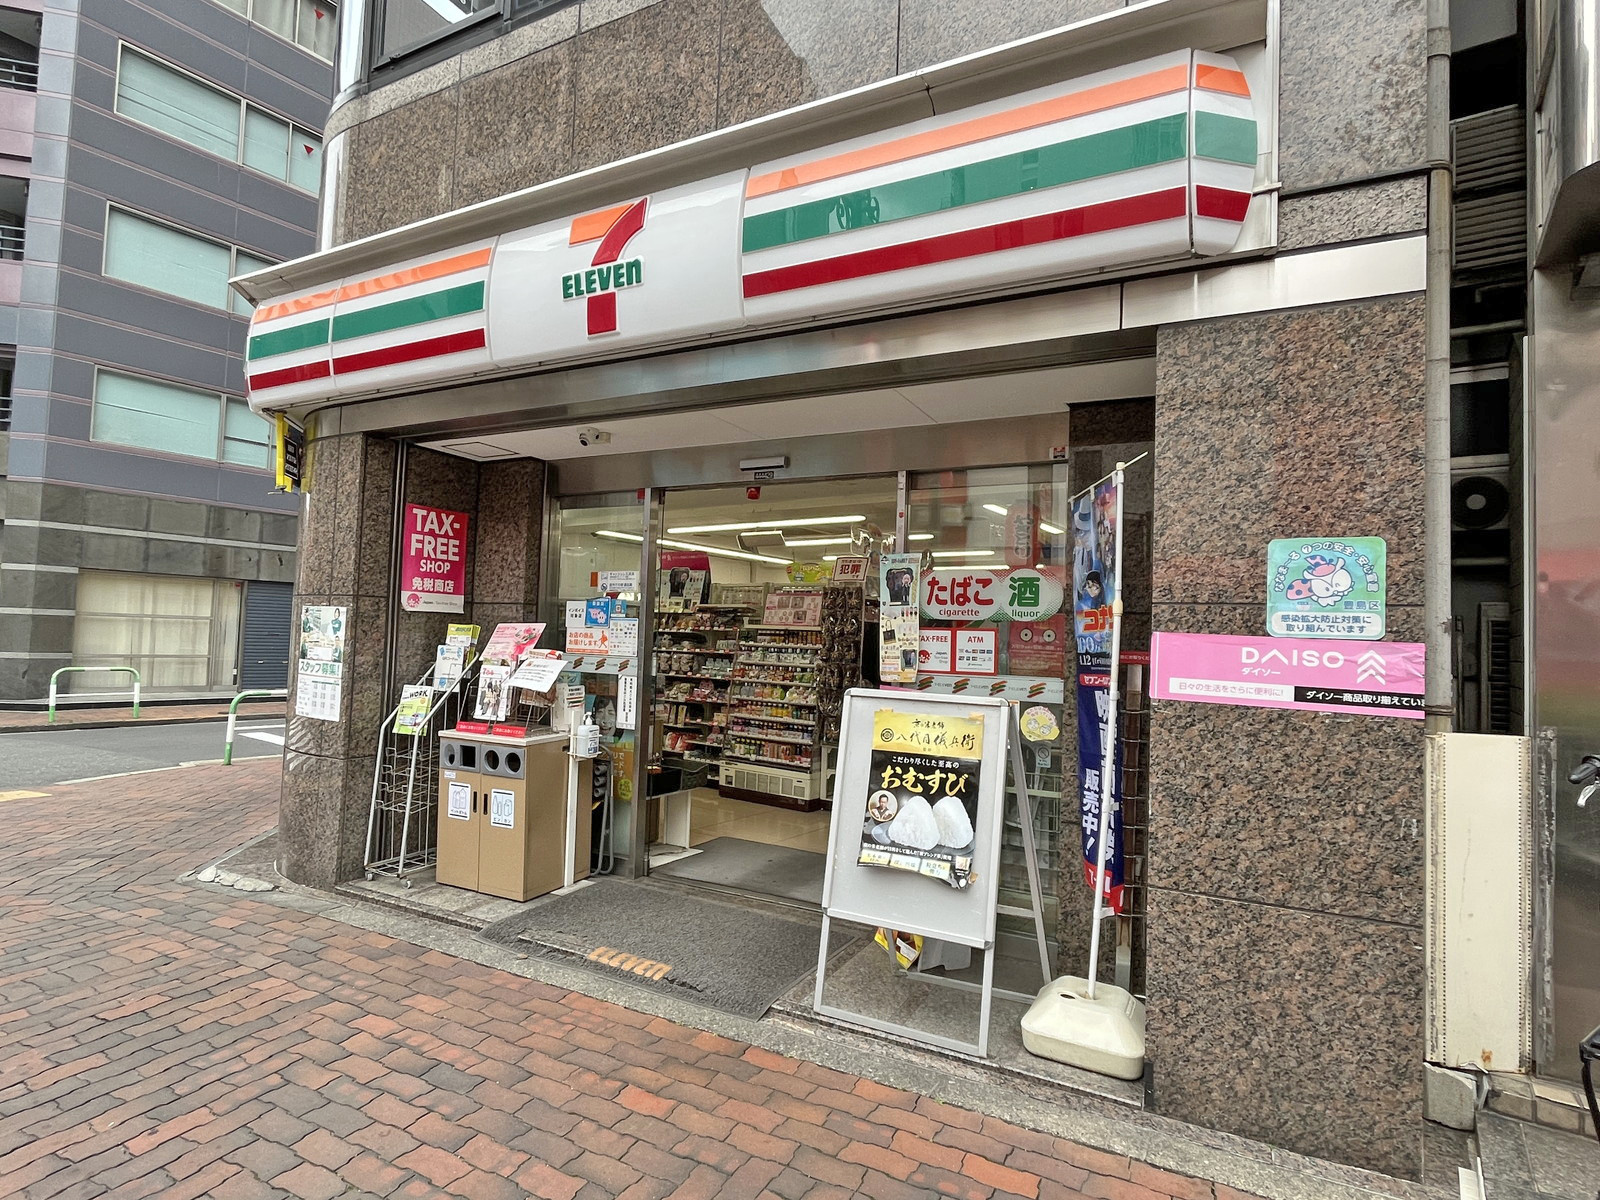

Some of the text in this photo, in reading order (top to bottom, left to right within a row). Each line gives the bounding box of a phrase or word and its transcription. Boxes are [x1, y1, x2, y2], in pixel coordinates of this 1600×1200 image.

[568, 197, 648, 336] 7
[412, 507, 460, 537] TAX-
[410, 533, 460, 561] FREE
[420, 559, 451, 574] SHOP
[412, 576, 455, 593] 免税商店
[926, 575, 994, 606] たばこ
[1008, 576, 1041, 607] 酒
[939, 608, 980, 617] cigarette
[1343, 600, 1381, 610] 豊島区
[1011, 609, 1041, 618] liquor
[1280, 614, 1372, 625] 感染拡大防止対策に
[1286, 624, 1366, 634] 取り組んでいます
[1241, 647, 1344, 668] DAISO
[1241, 666, 1281, 677] ダイソー
[409, 689, 429, 698] WORK
[892, 756, 960, 769] こだわり尽くした至高の
[881, 764, 969, 797] おむすび
